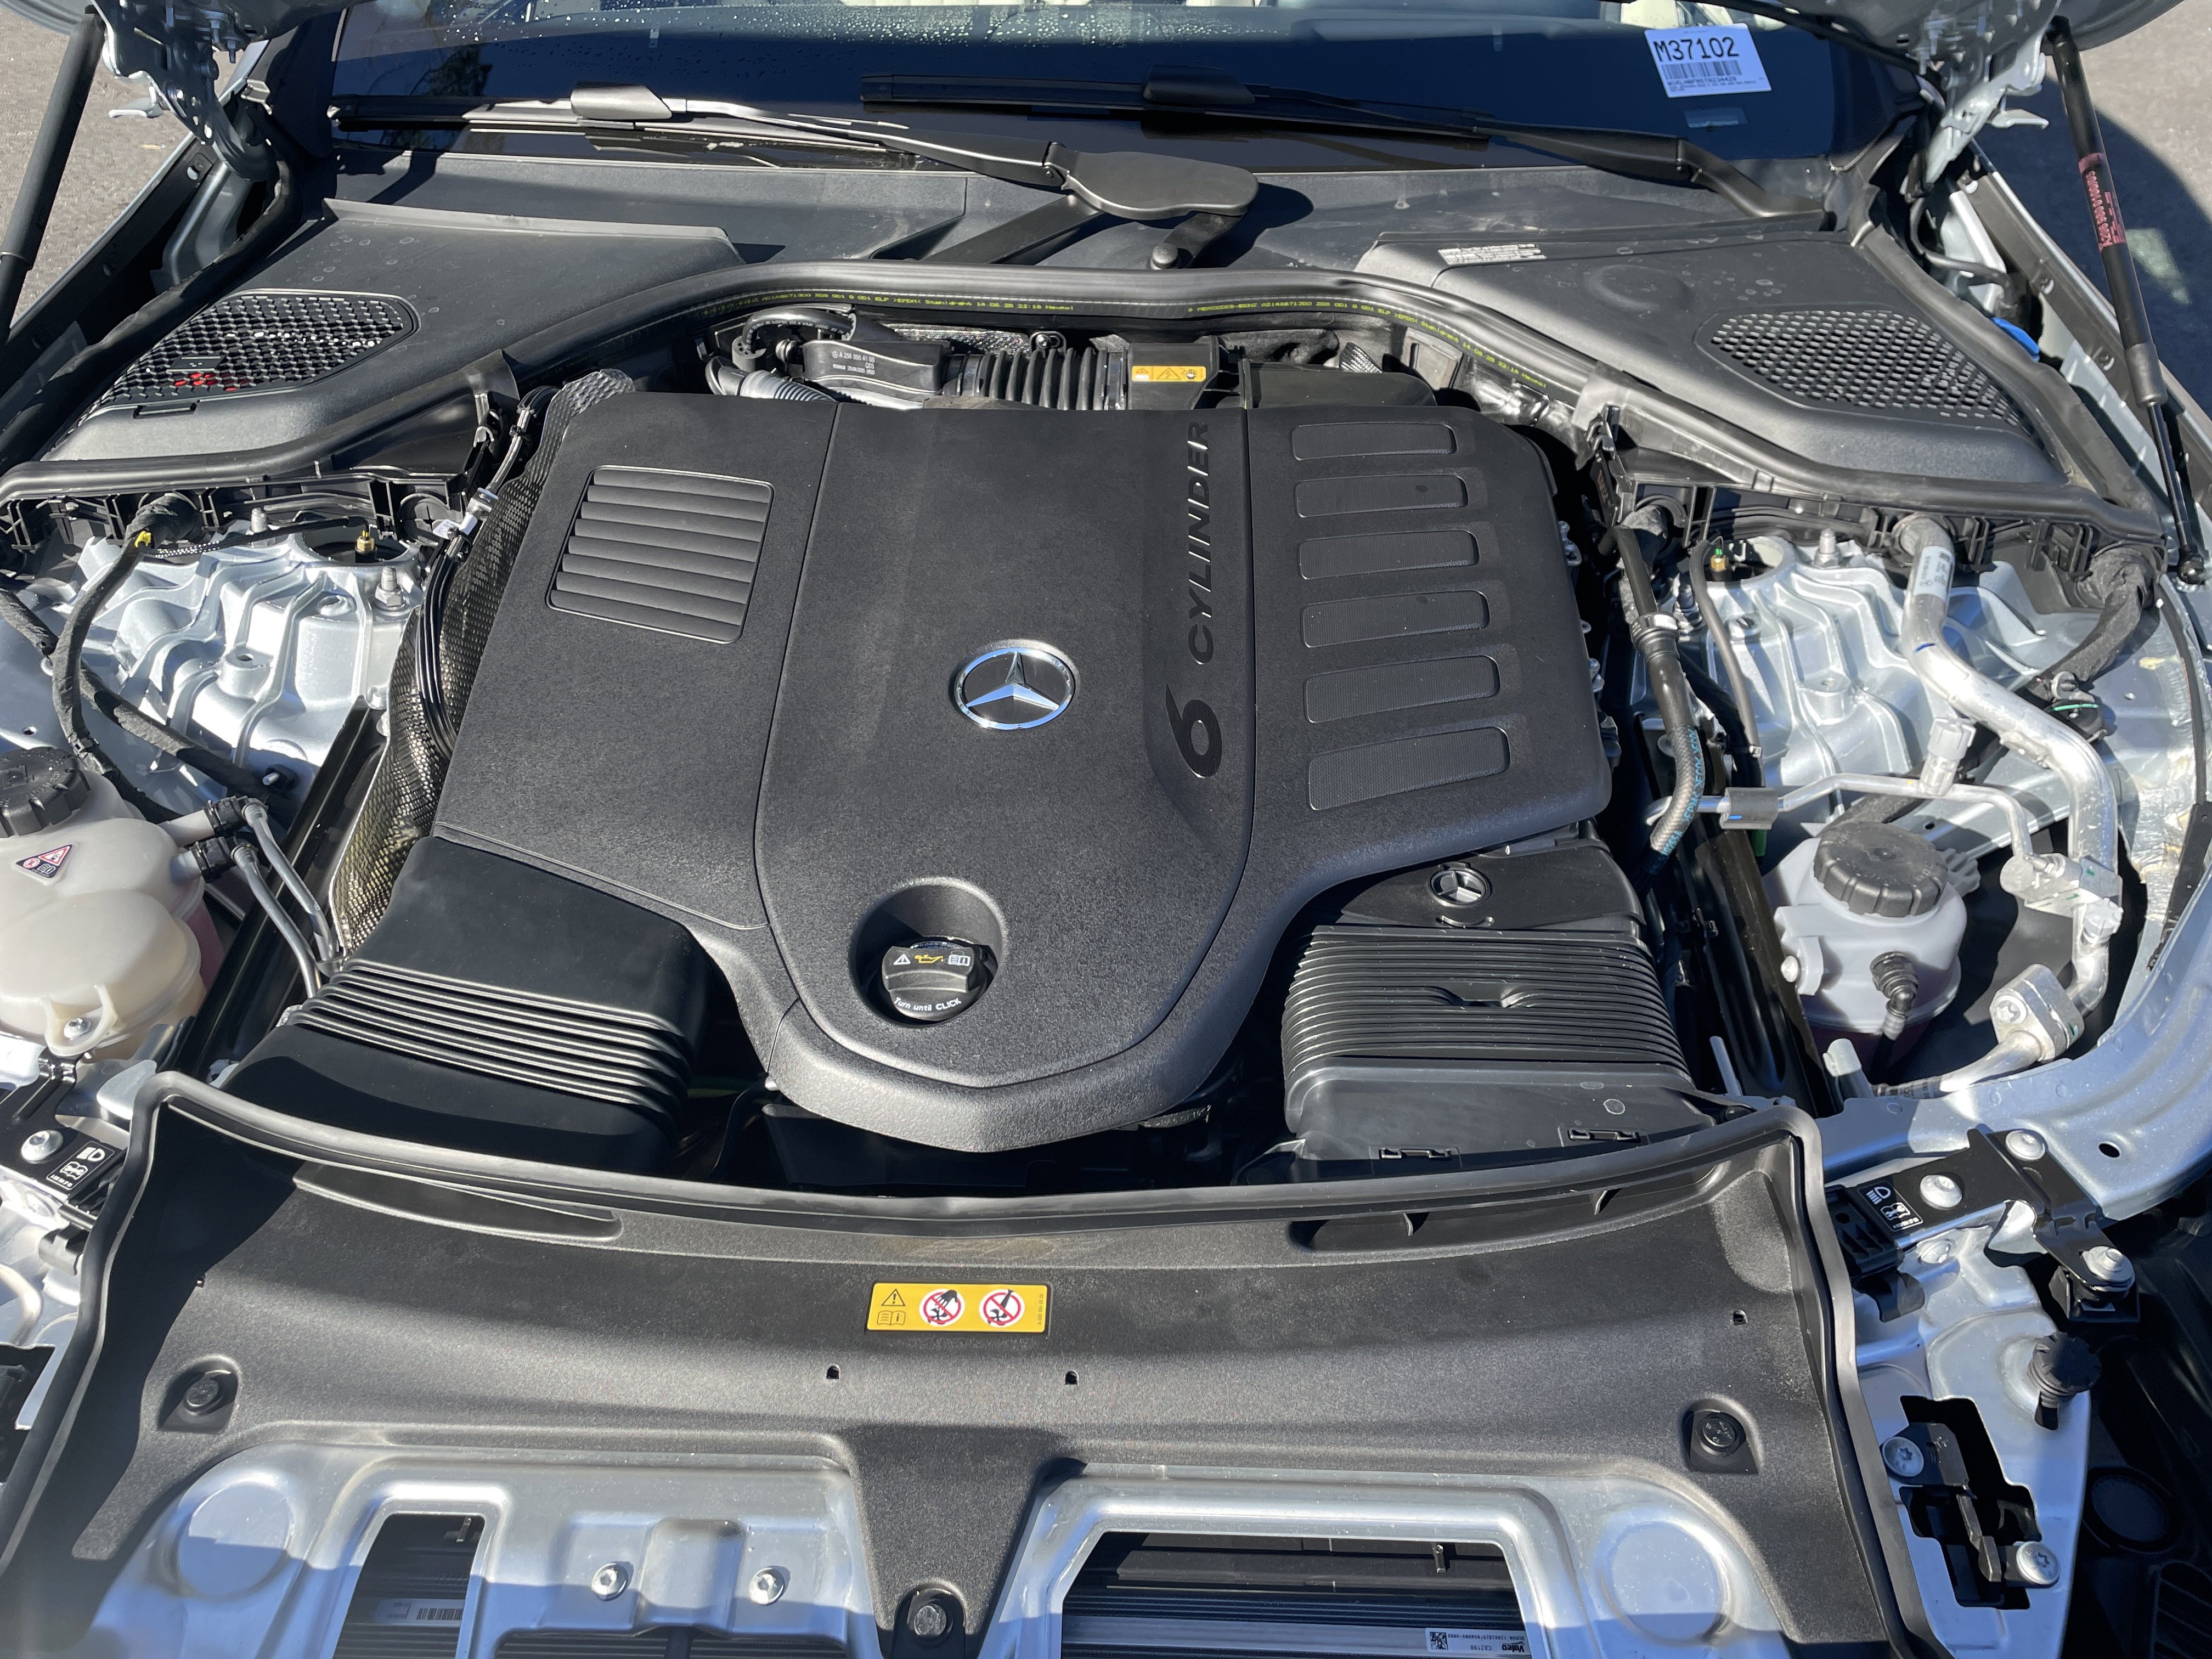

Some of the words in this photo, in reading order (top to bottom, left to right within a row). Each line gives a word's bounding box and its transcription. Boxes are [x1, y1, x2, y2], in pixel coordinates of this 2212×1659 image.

[1652, 36, 1740, 62] M37102
[1187, 421, 1214, 665] CYLINDER
[1165, 684, 1222, 778] 6
[894, 997, 911, 1010] Turn
[935, 997, 962, 1011] CLICK
[1502, 1643, 1525, 1653] Valeo
